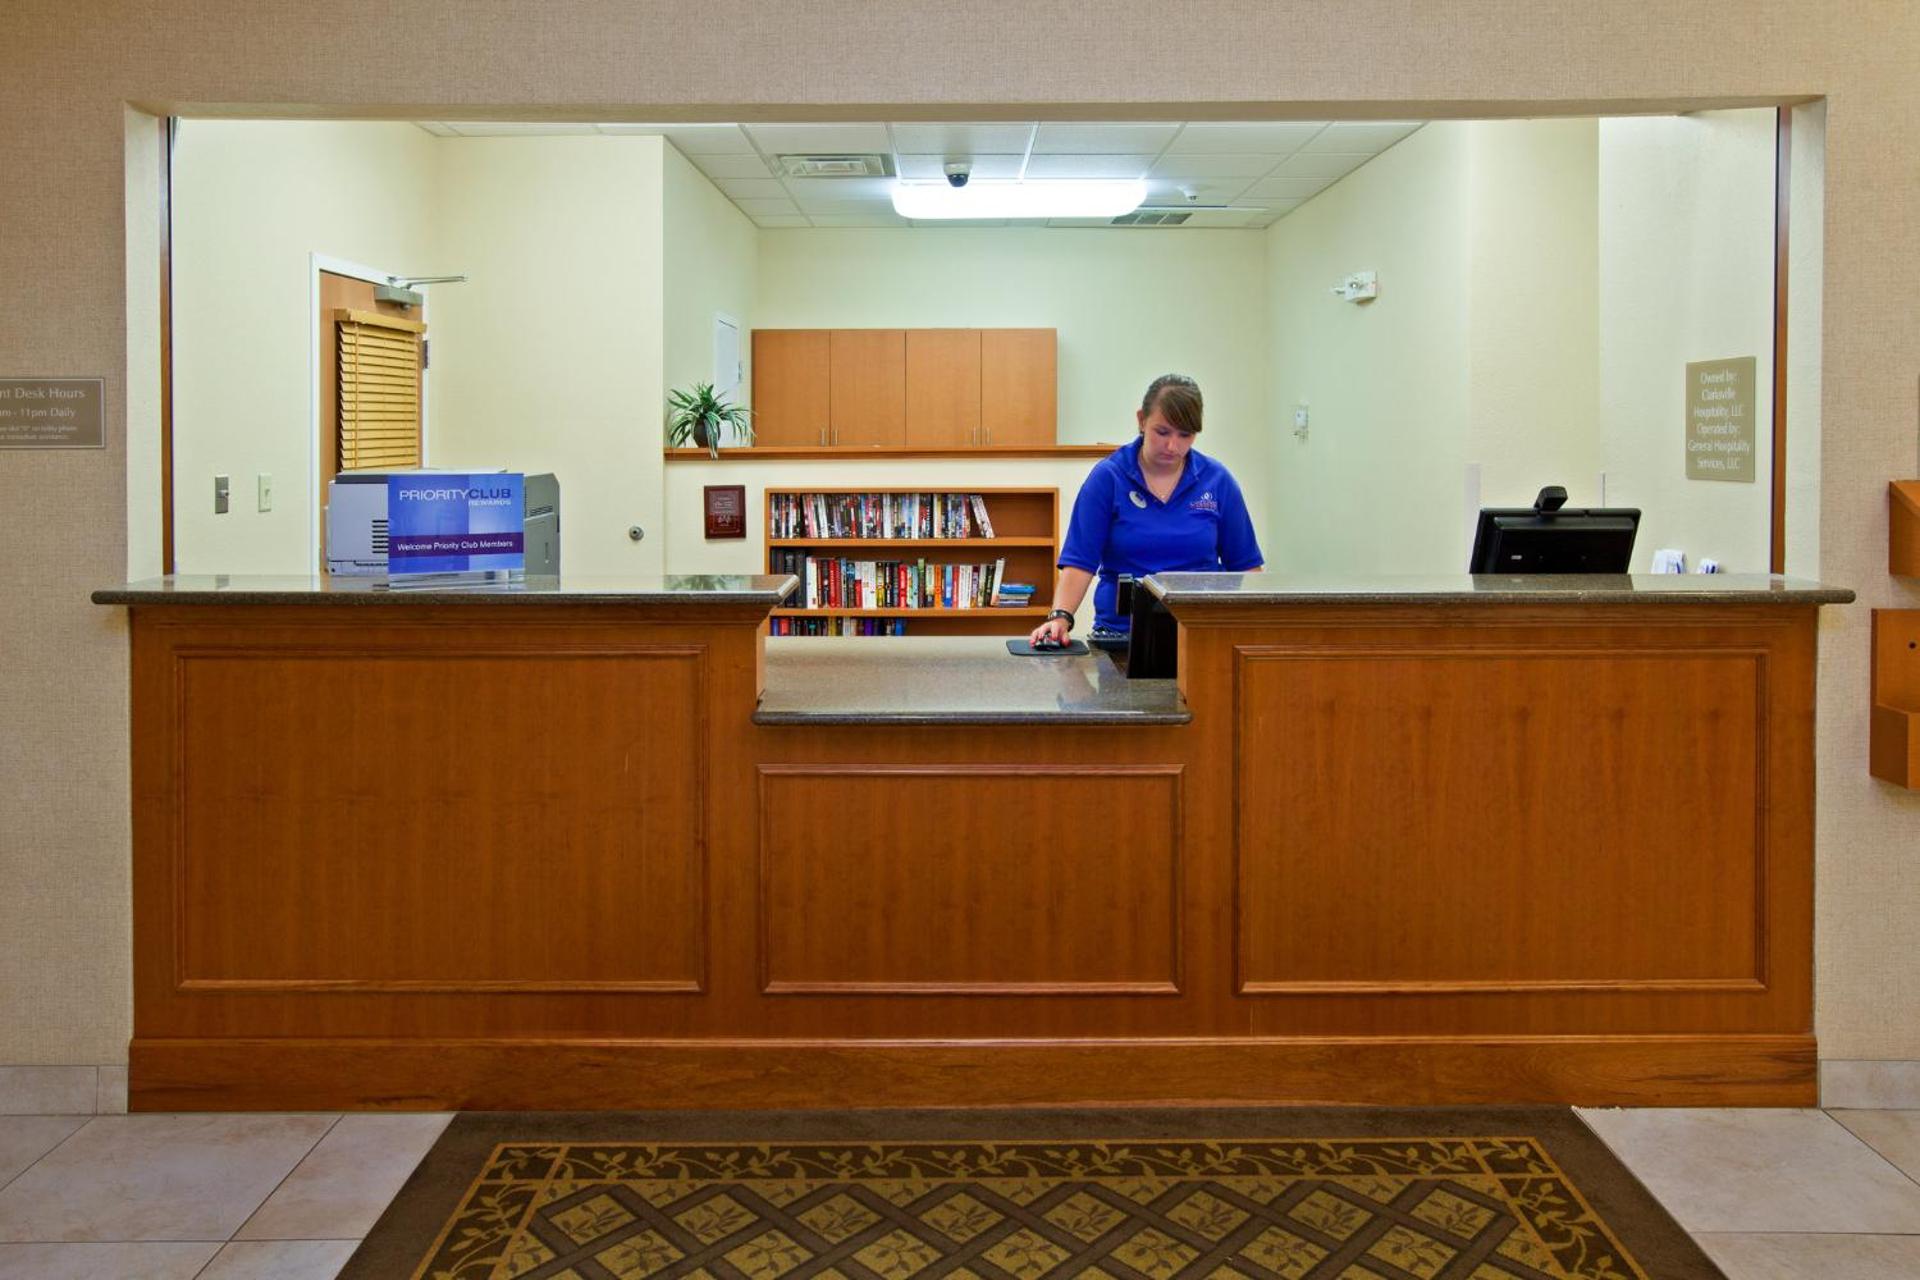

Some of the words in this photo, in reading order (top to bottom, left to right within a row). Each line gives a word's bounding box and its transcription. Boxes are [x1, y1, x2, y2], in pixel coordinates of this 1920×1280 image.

[15, 387, 45, 398] Desk
[49, 387, 86, 398] Hours
[50, 407, 77, 419] Daily
[397, 543, 432, 551] Welcome
[434, 541, 459, 551] Priority
[461, 540, 478, 549] Club
[480, 540, 513, 548] Members
